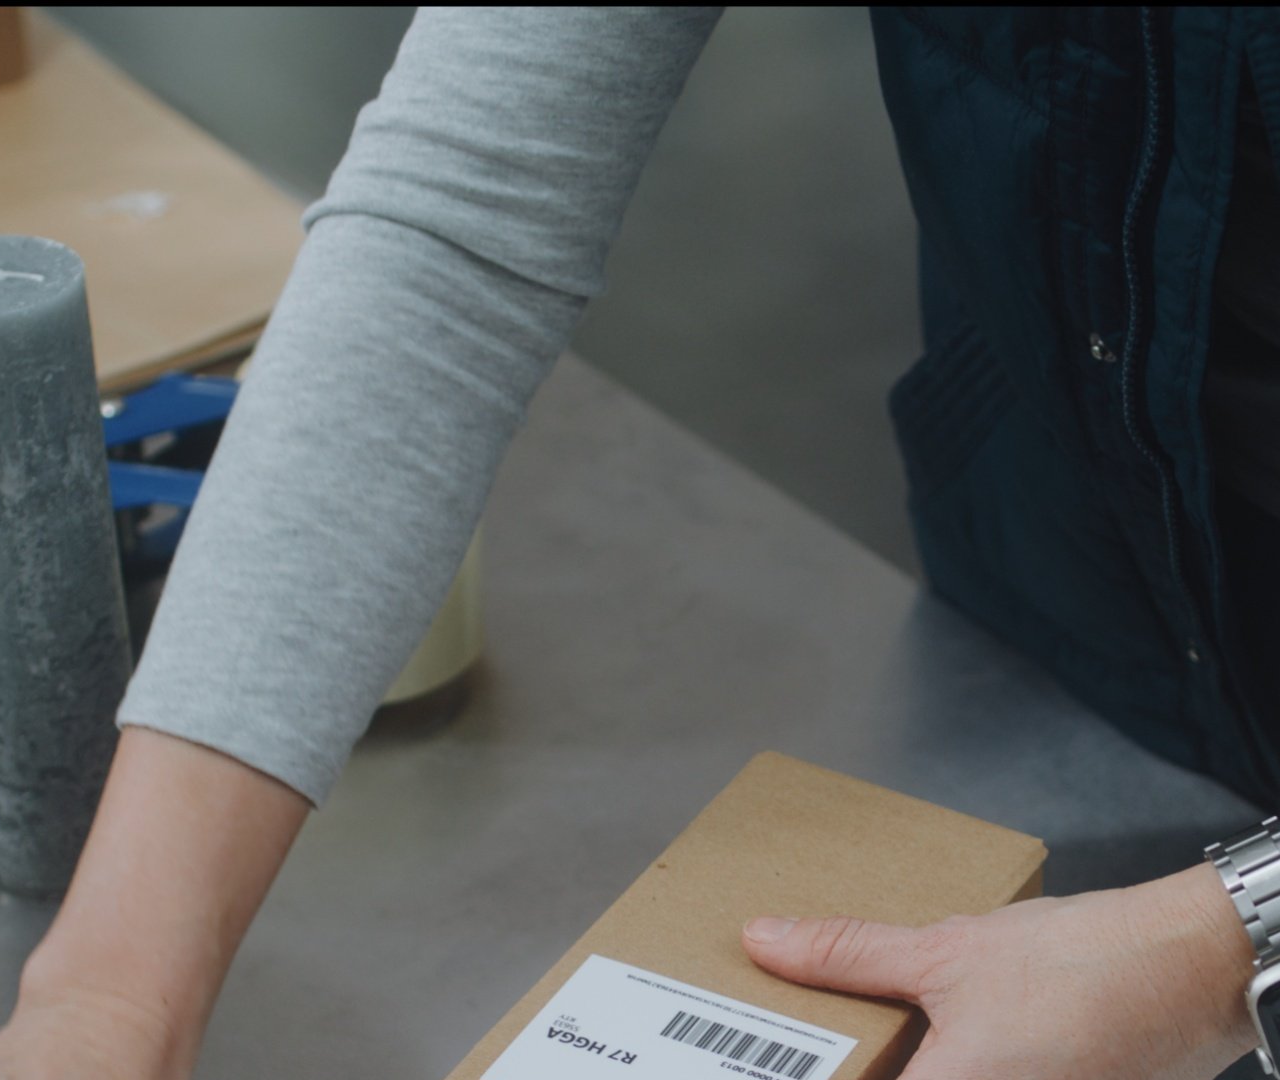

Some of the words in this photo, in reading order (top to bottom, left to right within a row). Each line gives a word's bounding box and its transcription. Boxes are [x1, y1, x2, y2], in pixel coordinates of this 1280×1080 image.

[552, 1019, 579, 1032] 55633
[546, 1026, 606, 1054] HGGA
[607, 1049, 637, 1064] R7
[719, 1061, 746, 1073] 0013
[746, 1070, 773, 1080] 0000
